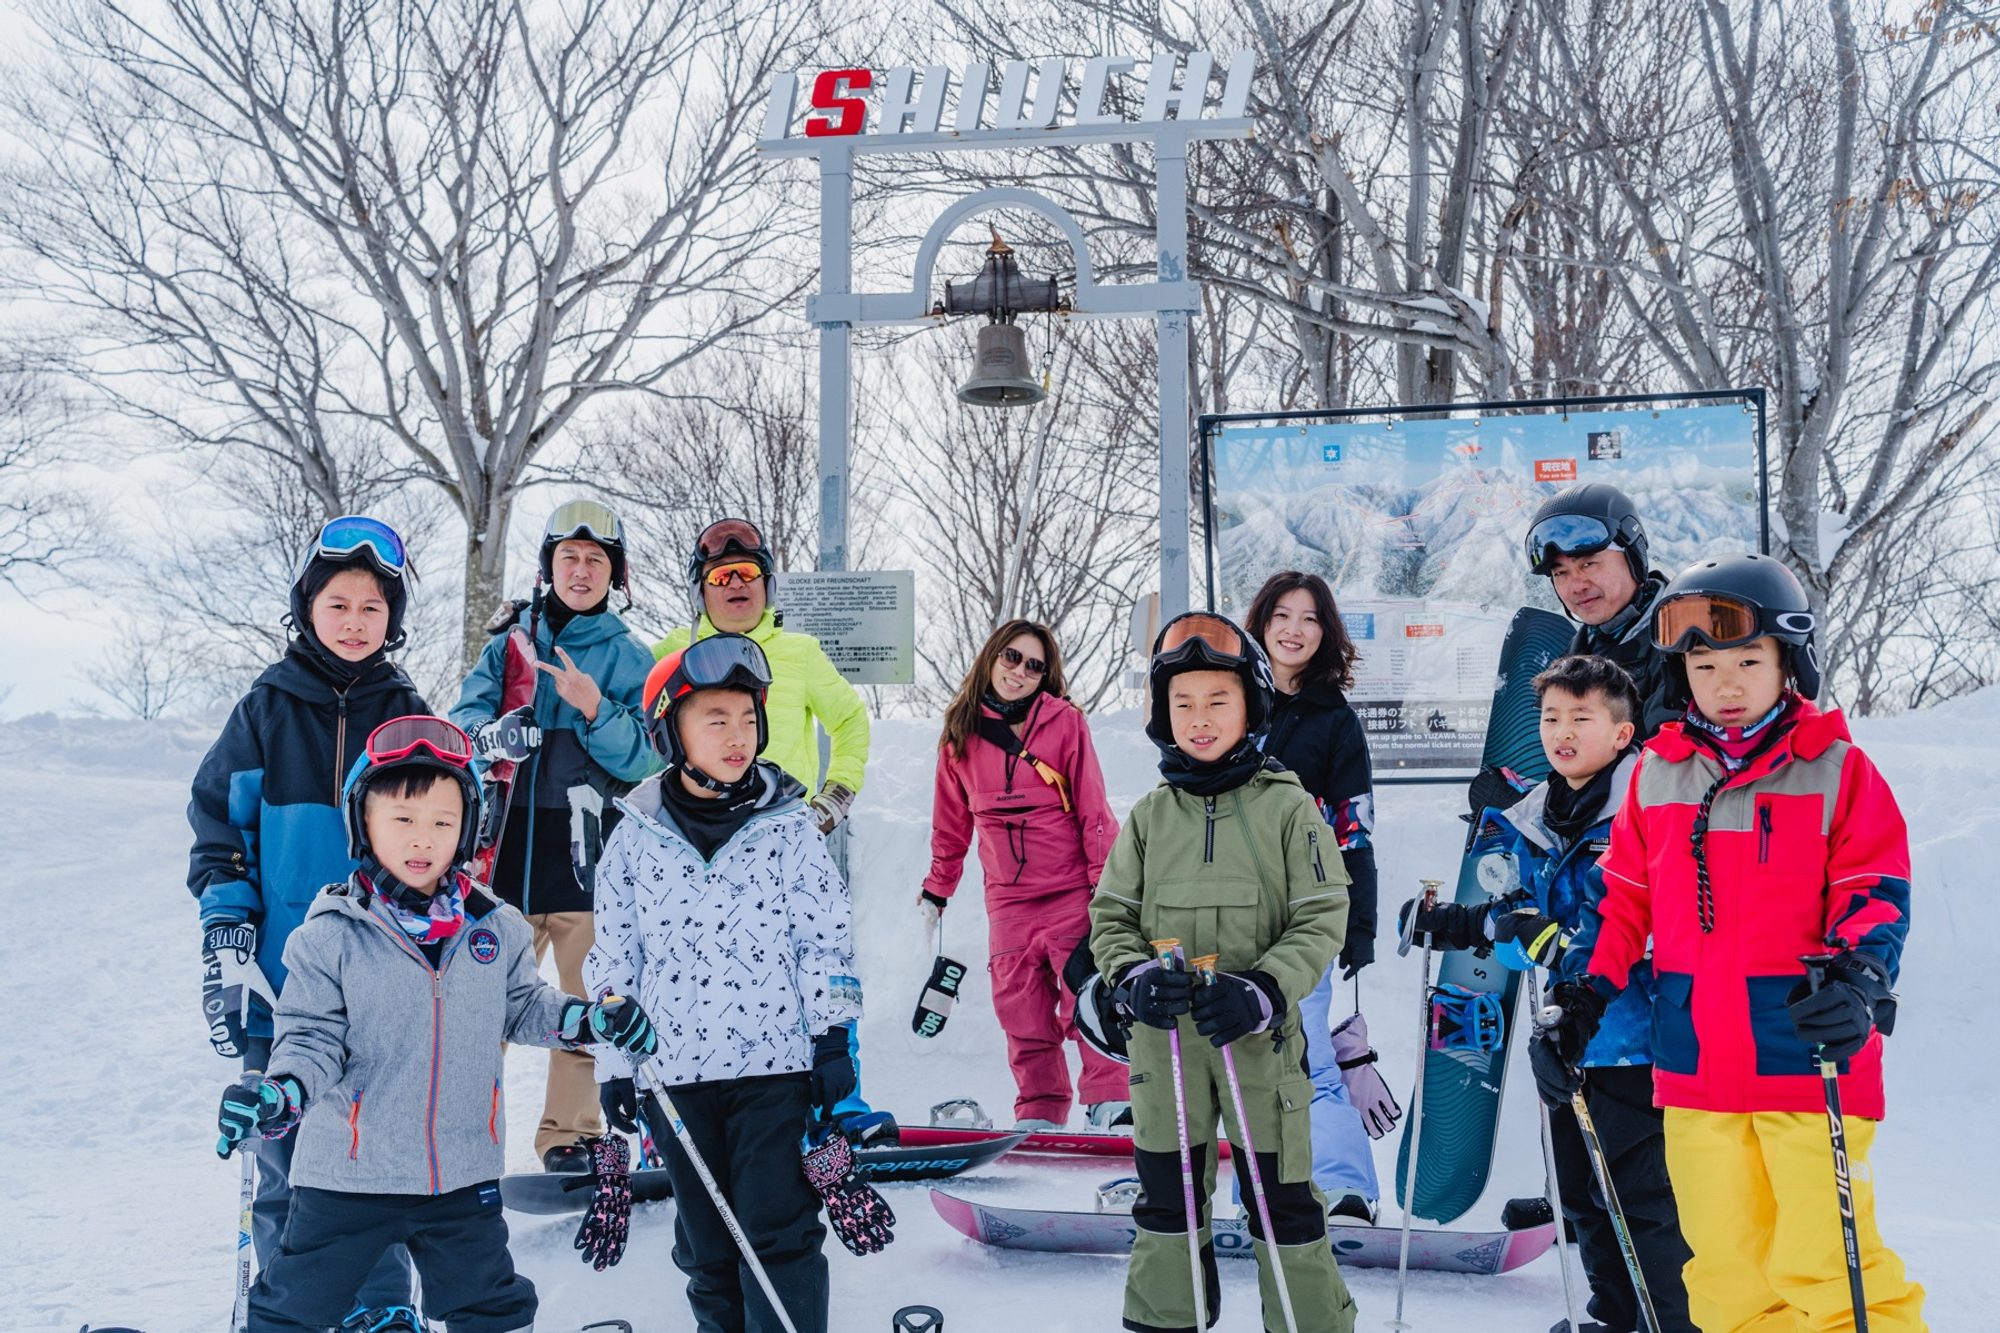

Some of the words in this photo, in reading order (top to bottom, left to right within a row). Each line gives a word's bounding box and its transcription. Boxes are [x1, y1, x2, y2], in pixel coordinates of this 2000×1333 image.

[761, 50, 1256, 139] ISHIUCHI
[1541, 462, 1571, 472] 現在地
[1355, 706, 1491, 718] 共通券のアップグレード券の
[916, 1012, 943, 1038] FOR
[940, 966, 962, 991] NO
[1171, 1054, 1189, 1164] COMPETITION
